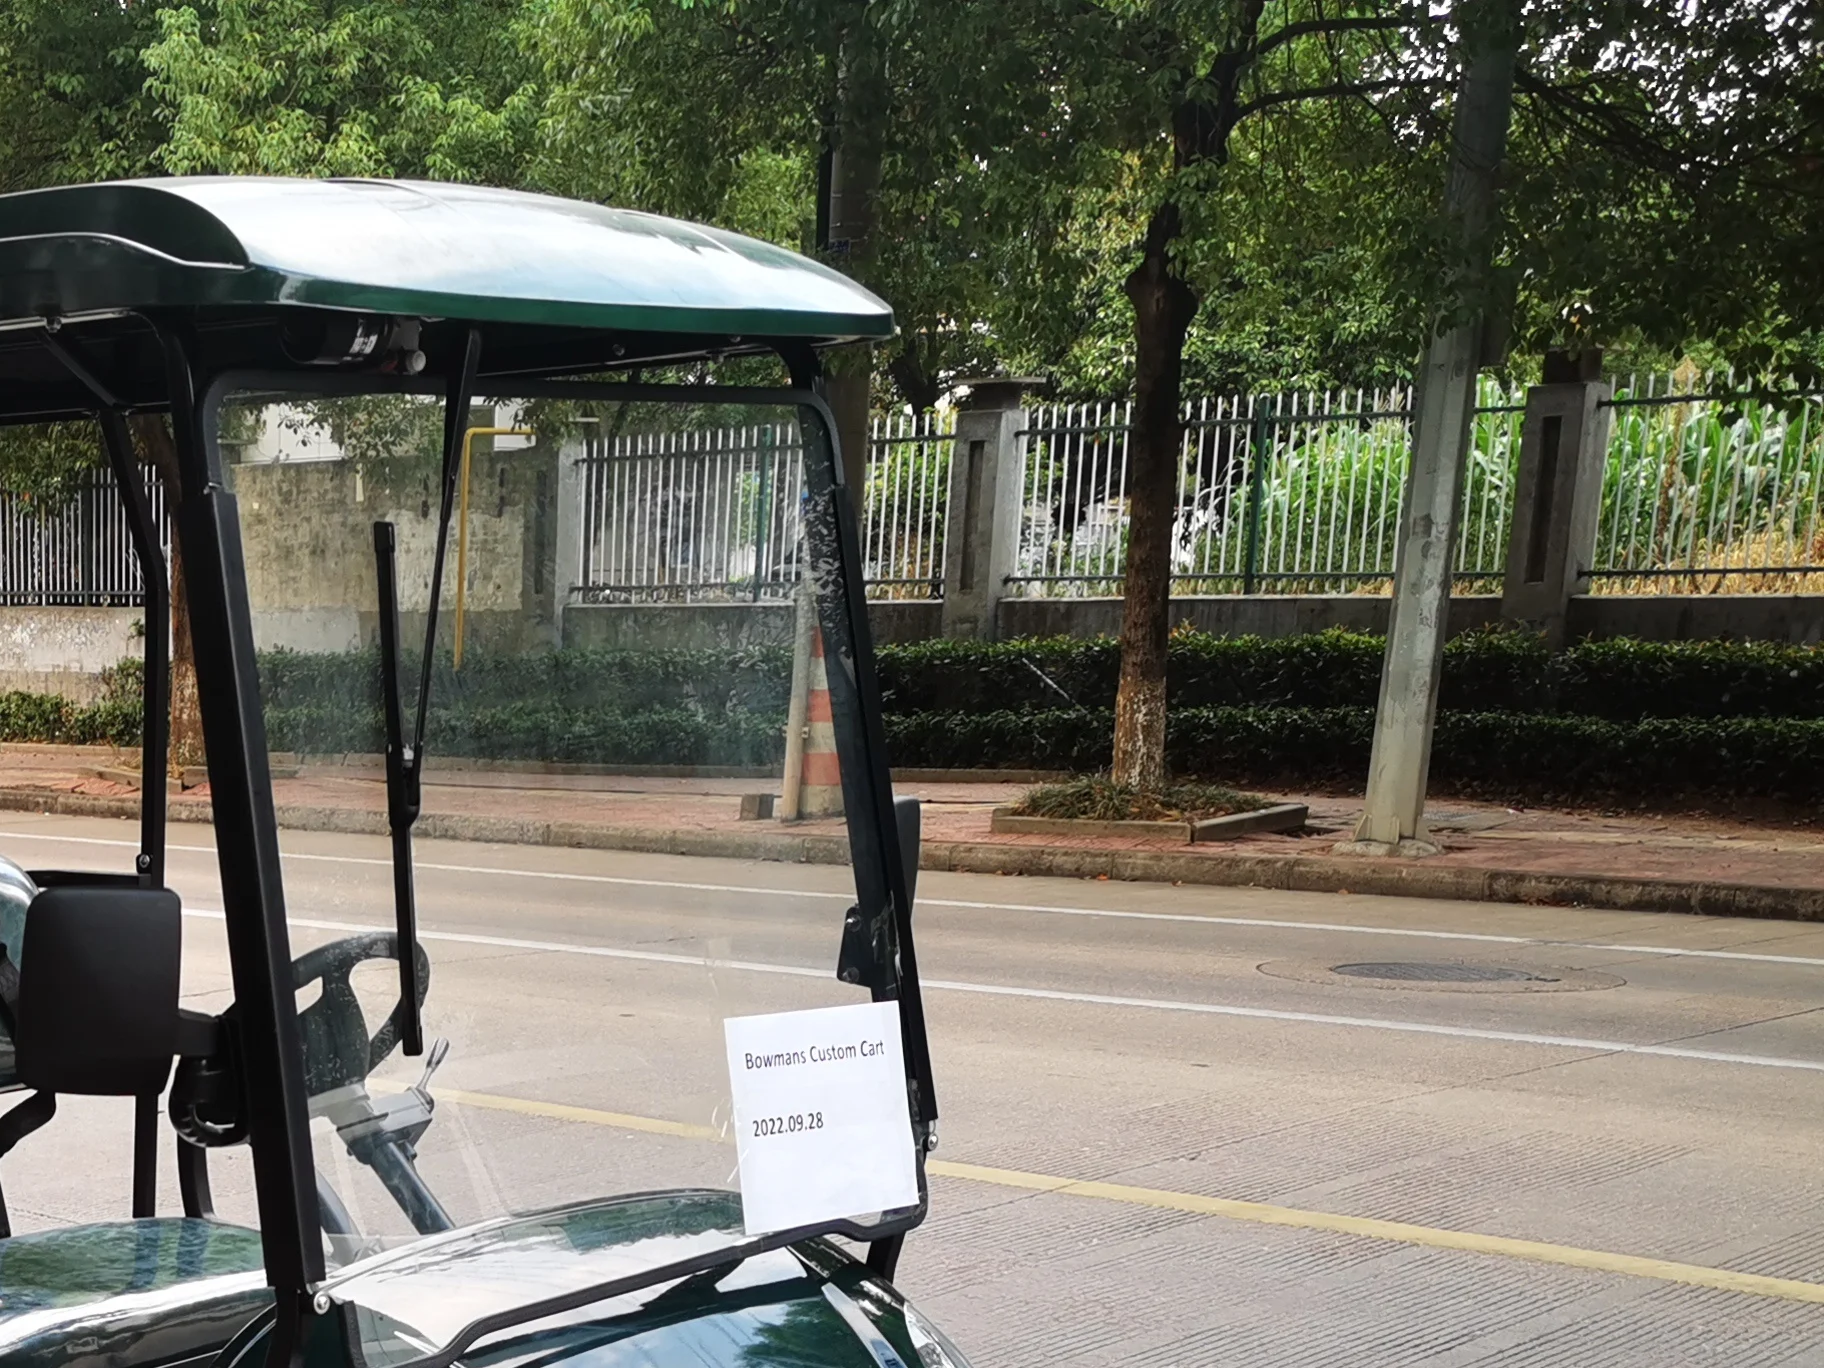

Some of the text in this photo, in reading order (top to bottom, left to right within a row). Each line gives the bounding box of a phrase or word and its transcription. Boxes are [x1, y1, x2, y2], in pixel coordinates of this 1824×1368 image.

[745, 1040, 885, 1070] Bowmans Custom Cart
[752, 1111, 824, 1137] 2022.09.28
